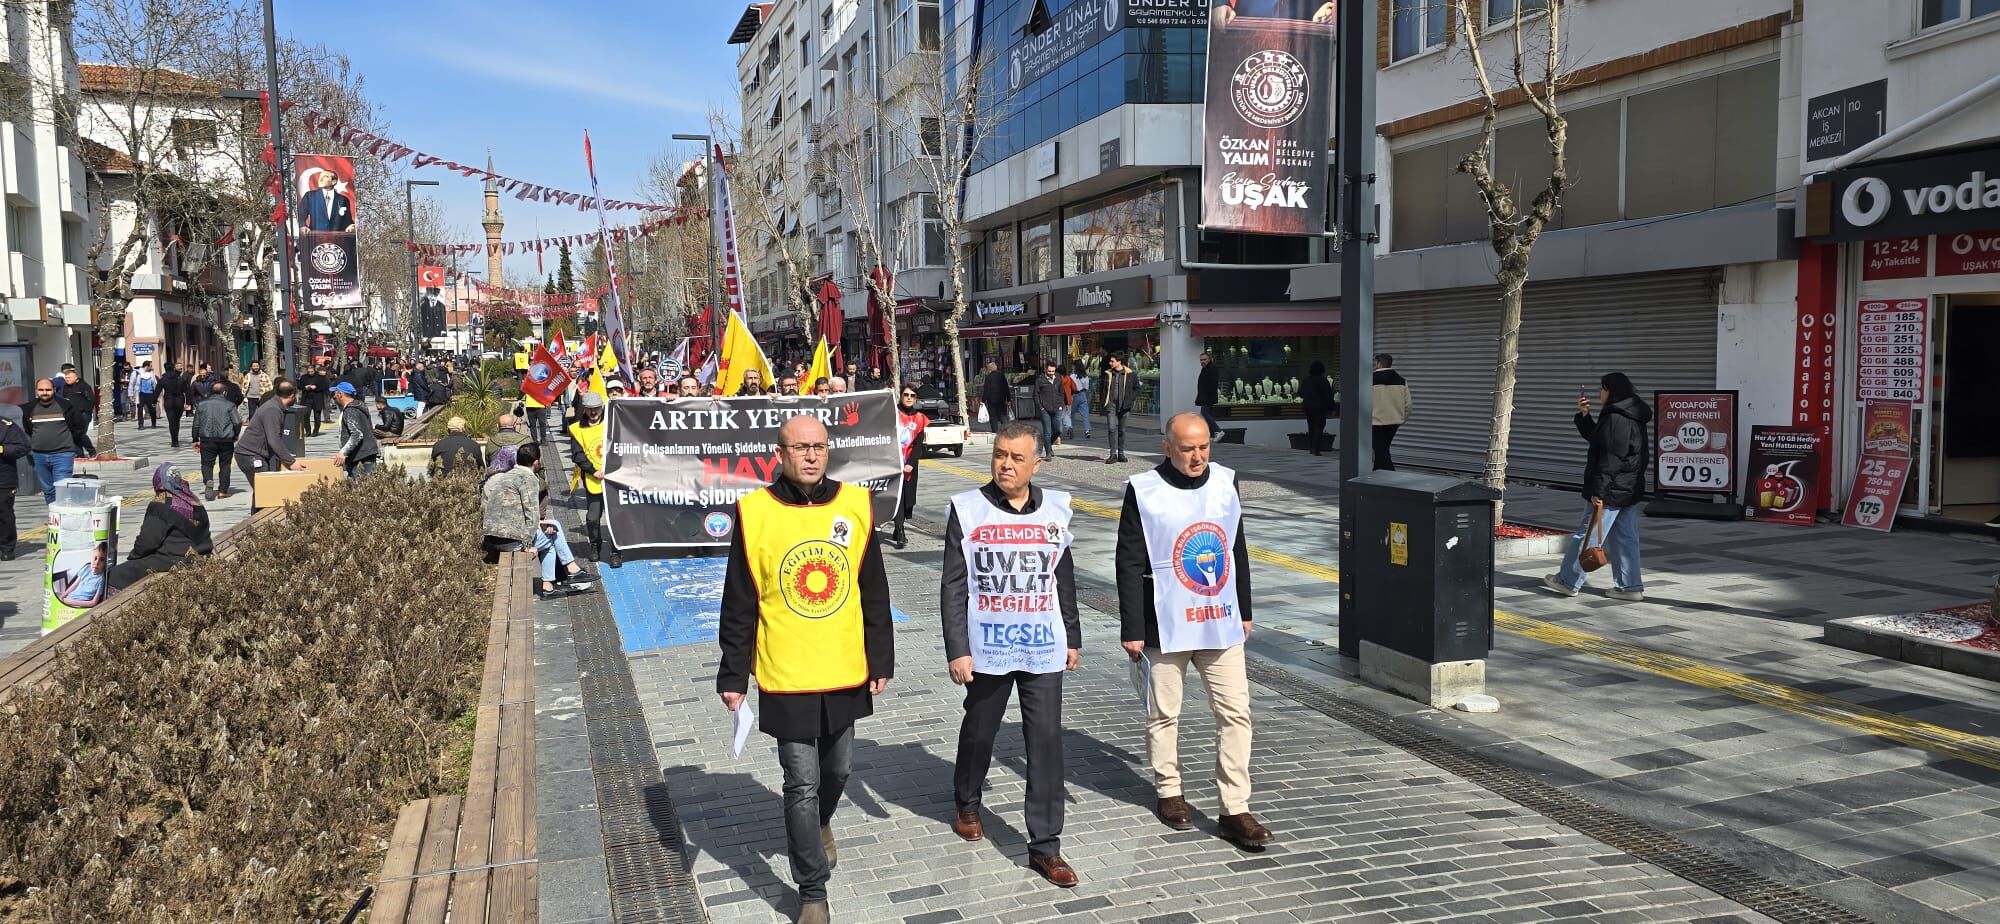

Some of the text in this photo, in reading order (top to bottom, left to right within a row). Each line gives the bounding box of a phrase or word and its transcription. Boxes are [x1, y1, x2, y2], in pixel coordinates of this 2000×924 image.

[1066, 0, 1102, 32] ÜNAL
[1812, 100, 1861, 120] AKCAN no
[1822, 110, 1883, 136] İŞ 1
[1219, 136, 1269, 151] ÖZKAN
[1809, 131, 1842, 148] MERKEZİ
[1222, 152, 1269, 166] YALIM
[1276, 148, 1316, 158] BELEDİYE
[1275, 158, 1312, 167] BAŞKANI
[1222, 184, 1309, 211] UŞAK
[1903, 171, 2000, 216] voda
[1873, 242, 1890, 255] 12
[1901, 239, 1919, 253] 24
[1870, 256, 1920, 269] Ay Taksitle
[1962, 260, 1989, 272] UŞAK
[1895, 313, 1916, 321] 185
[1894, 324, 1915, 332] 210
[1894, 335, 1914, 343] 251
[1894, 346, 1914, 354] 325
[1893, 357, 1914, 365] 488
[1893, 368, 1914, 376] 609
[1893, 379, 1913, 387] 791
[1893, 390, 1913, 398] 840
[1669, 401, 1718, 409] VODAFONE
[649, 410, 739, 430] ARTIK
[1681, 427, 1705, 437] 100
[1767, 435, 1776, 443] Ay
[613, 442, 641, 457] Eğitim
[642, 443, 700, 458] Çalışanlarına
[702, 442, 733, 455] Yönelik
[734, 441, 767, 456] Şiddete
[836, 434, 891, 449] Katledilmesine
[1683, 437, 1705, 445] MBPS
[1878, 440, 1893, 448] 500
[703, 456, 779, 485] HAY
[1666, 466, 1712, 483] 709
[1861, 460, 1902, 478] 25 GB
[1866, 477, 1883, 486] 750
[619, 486, 695, 506] EĞİTİMDE
[1859, 501, 1881, 515] 175
[1862, 516, 1872, 524] TL
[980, 527, 1047, 541] EYLEMDEY
[784, 546, 847, 576] EĞİTİM SEN
[974, 547, 1051, 573] ÜVEY
[977, 574, 1050, 593] EVLAT
